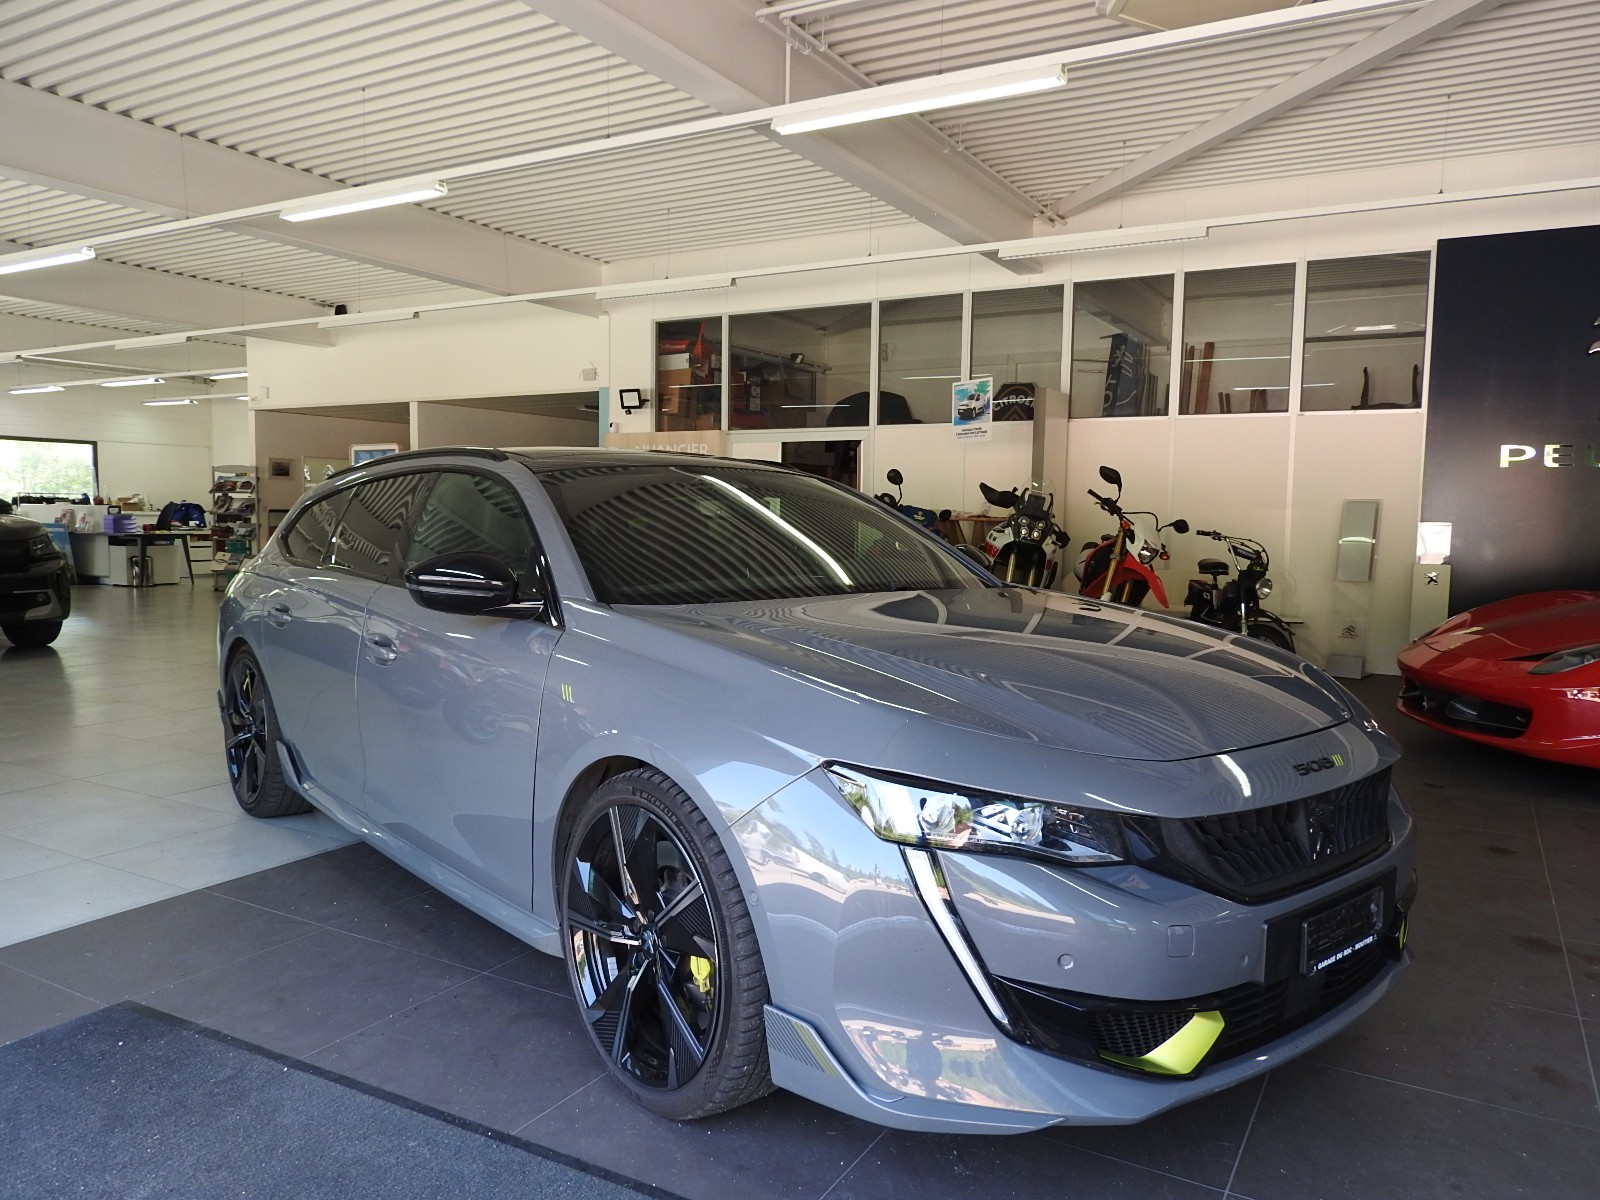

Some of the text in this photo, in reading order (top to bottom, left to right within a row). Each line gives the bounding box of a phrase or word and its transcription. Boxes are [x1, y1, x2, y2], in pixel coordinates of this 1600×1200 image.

[1293, 757, 1335, 777] 508
[641, 791, 678, 823] MICHELIN
[1317, 955, 1337, 970] GARAGE
[1354, 935, 1374, 951] MOUTIER
